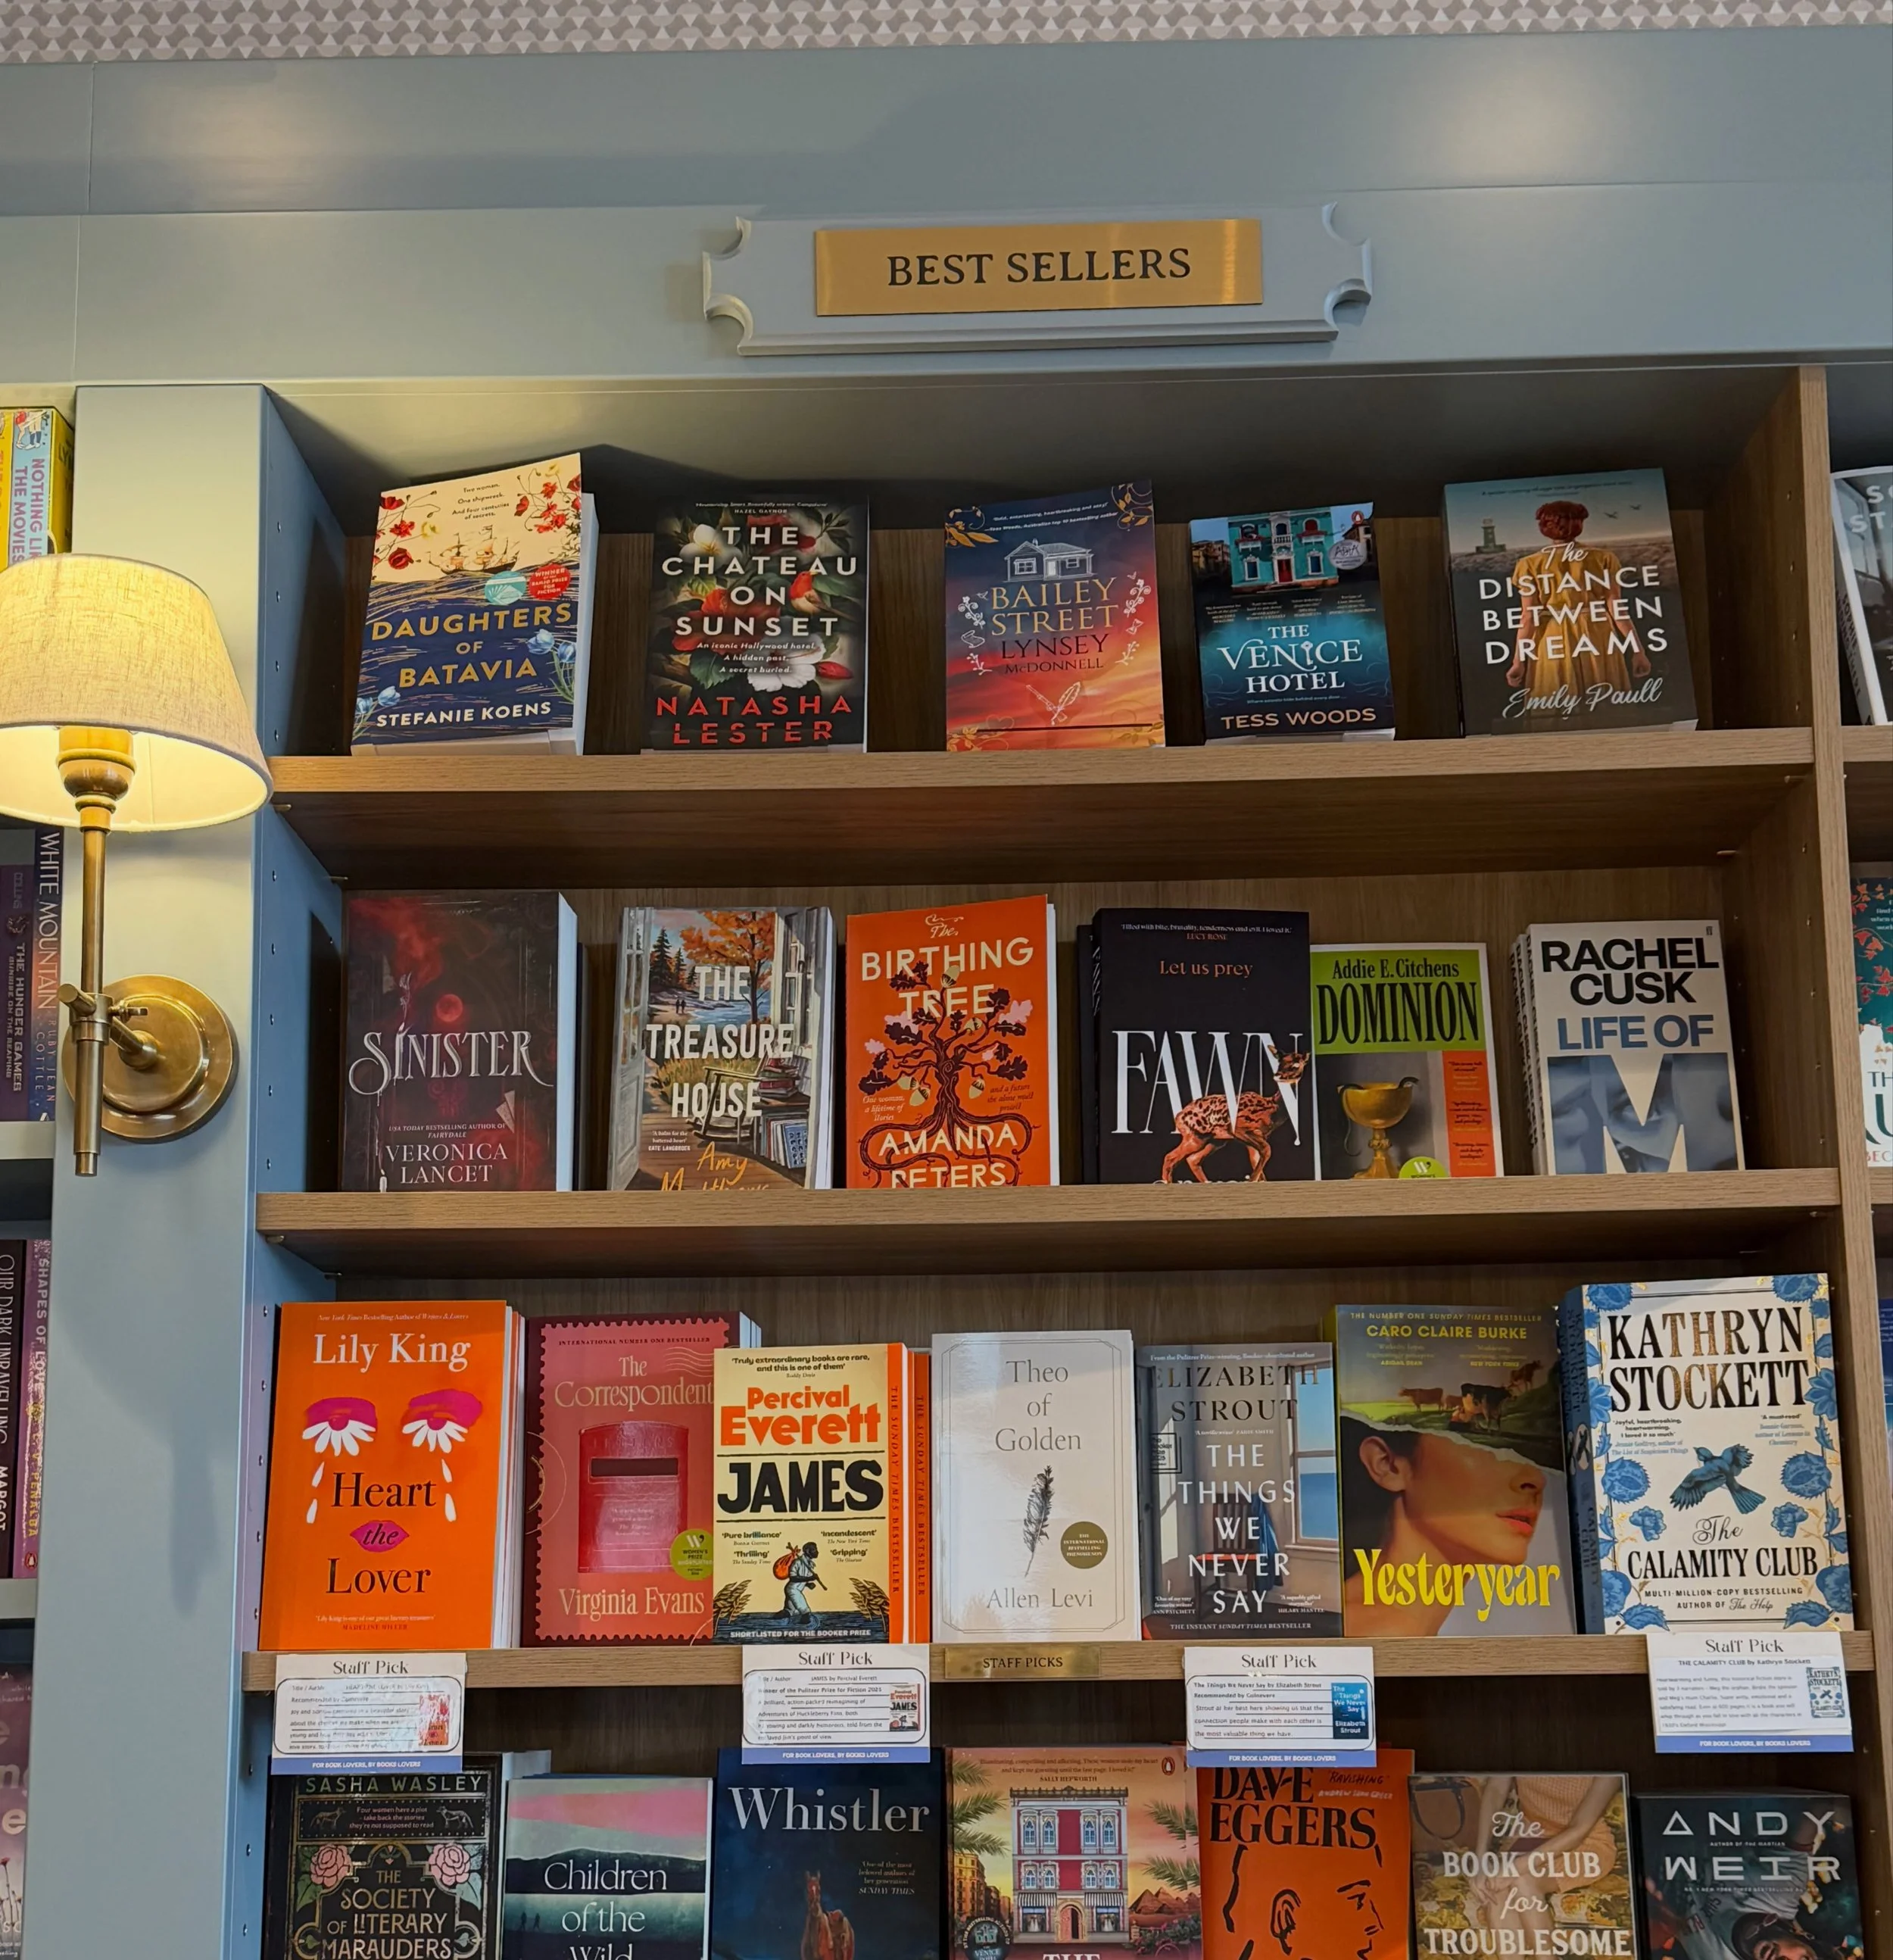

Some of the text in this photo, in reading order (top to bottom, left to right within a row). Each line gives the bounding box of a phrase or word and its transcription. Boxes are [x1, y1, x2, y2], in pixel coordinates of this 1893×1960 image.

[887, 248, 1191, 286] BEST SELLERS
[30, 458, 45, 533] NOTHING
[12, 466, 28, 563] THE MOVIES
[722, 526, 799, 545] THE
[662, 557, 857, 576] CHATEAU
[1541, 541, 1589, 570] The
[729, 585, 786, 606] ON
[990, 576, 1118, 610] BAILEY
[1479, 564, 1661, 600] DISTANCE
[371, 603, 572, 641] DAUGHTERS
[675, 616, 838, 636] SUNSET
[991, 605, 1119, 636] STREET
[1483, 596, 1663, 632] BETWEEN
[1268, 624, 1309, 639] THE
[456, 641, 482, 655] OF
[741, 642, 788, 651] Hollywood
[1001, 633, 1109, 660] LYNSEY
[1217, 638, 1363, 672] VENICE
[1486, 628, 1668, 665] DREAMS
[399, 658, 537, 688] BATAVIA
[1005, 657, 1104, 675] McDONNELL
[1246, 670, 1346, 694] HOTEL
[656, 695, 852, 716] NATASHA
[1502, 677, 1664, 720] Emily Paull
[376, 702, 551, 728] STEFANIE KOENS
[1221, 707, 1377, 730] TESS WOODS
[673, 721, 833, 744] LESTER
[38, 832, 61, 1010] WHITE MOUNTAIN
[925, 913, 964, 939] The
[862, 936, 1034, 982] BIRTHING
[1332, 957, 1460, 980] Addie E. Citchens
[1541, 937, 1720, 972] RACHEL
[694, 965, 751, 1001] THE
[1159, 960, 1253, 978] Let us prey
[899, 983, 995, 1019] TREE
[1570, 971, 1697, 1006] CUSK
[1316, 981, 1480, 1045] DOMINION
[646, 1023, 795, 1060] TREASURE
[1557, 1014, 1714, 1050] LIFE OF
[35, 1031, 45, 1091] COTTLE
[46, 1019, 57, 1102] RUBY JEAN
[348, 1028, 554, 1096] SINISTER
[671, 1081, 763, 1119] HOUSE
[1111, 1030, 1303, 1147] FAWN
[1546, 1052, 1740, 1175] M
[385, 1142, 509, 1163] VERONICA
[878, 1122, 1018, 1157] AMANDA
[401, 1164, 493, 1184] LANCET
[697, 1141, 748, 1186] Amy
[36, 1259, 49, 1319] SHAPES
[36, 1325, 46, 1344] OF
[1367, 1325, 1527, 1340] CARO CLAIRE BURKE
[1607, 1306, 1804, 1360] KATHRYN
[313, 1333, 472, 1373] Lily King
[618, 1355, 647, 1378] The
[1006, 1359, 1069, 1384] Theo
[1152, 1364, 1319, 1388] ELIZABETH
[1610, 1359, 1810, 1412] STOCKETT
[554, 1377, 714, 1412] Correspondent
[747, 1384, 850, 1410] Percival
[1027, 1393, 1053, 1417] of
[1171, 1399, 1298, 1422] STROUT
[721, 1403, 881, 1447] Everett
[994, 1427, 1082, 1452] Golden
[1205, 1443, 1264, 1467] THE
[330, 1472, 437, 1507] Heart
[717, 1459, 884, 1514] JAMES
[1177, 1479, 1296, 1504] THINGS
[361, 1523, 400, 1546] the
[1215, 1516, 1260, 1540] WE
[1692, 1515, 1743, 1545] The
[326, 1557, 432, 1594] Lover
[1188, 1552, 1290, 1577] NEVER
[1627, 1546, 1818, 1580] CALAMITY CLUB
[986, 1587, 1093, 1608] Allen Levi
[1353, 1548, 1561, 1622] Yesteryear
[1743, 1587, 1803, 1596] BESTSELLING
[559, 1587, 704, 1622] Virginia Evans
[1213, 1590, 1269, 1614] SAY
[1729, 1597, 1746, 1610] The
[1750, 1597, 1773, 1612] Help
[798, 1651, 872, 1665] Staff Pick
[1705, 1638, 1784, 1653] Staff Pick
[333, 1660, 408, 1674] Staff Pick
[983, 1656, 1063, 1668] STAFF PICKS
[1241, 1654, 1317, 1668] Staff Pick
[305, 1775, 482, 1793] SASHA WASLEY
[1213, 1767, 1314, 1803] DAVE
[728, 1787, 931, 1832] Whistler
[1663, 1809, 1835, 1837] ANDY
[1210, 1802, 1376, 1849] EGGERS
[1492, 1811, 1544, 1838] The
[376, 1870, 401, 1884] THE
[544, 1859, 667, 1890] Children
[1442, 1851, 1601, 1878] BOOK CLUB
[1665, 1855, 1842, 1881] WEIR
[341, 1887, 436, 1910] SOCIETY
[1500, 1887, 1548, 1920] for
[327, 1913, 448, 1934] OF LITERARY
[562, 1901, 646, 1933] of the
[320, 1938, 451, 1960] MARAUDERS
[1424, 1928, 1632, 1956] TROUBLESOME
